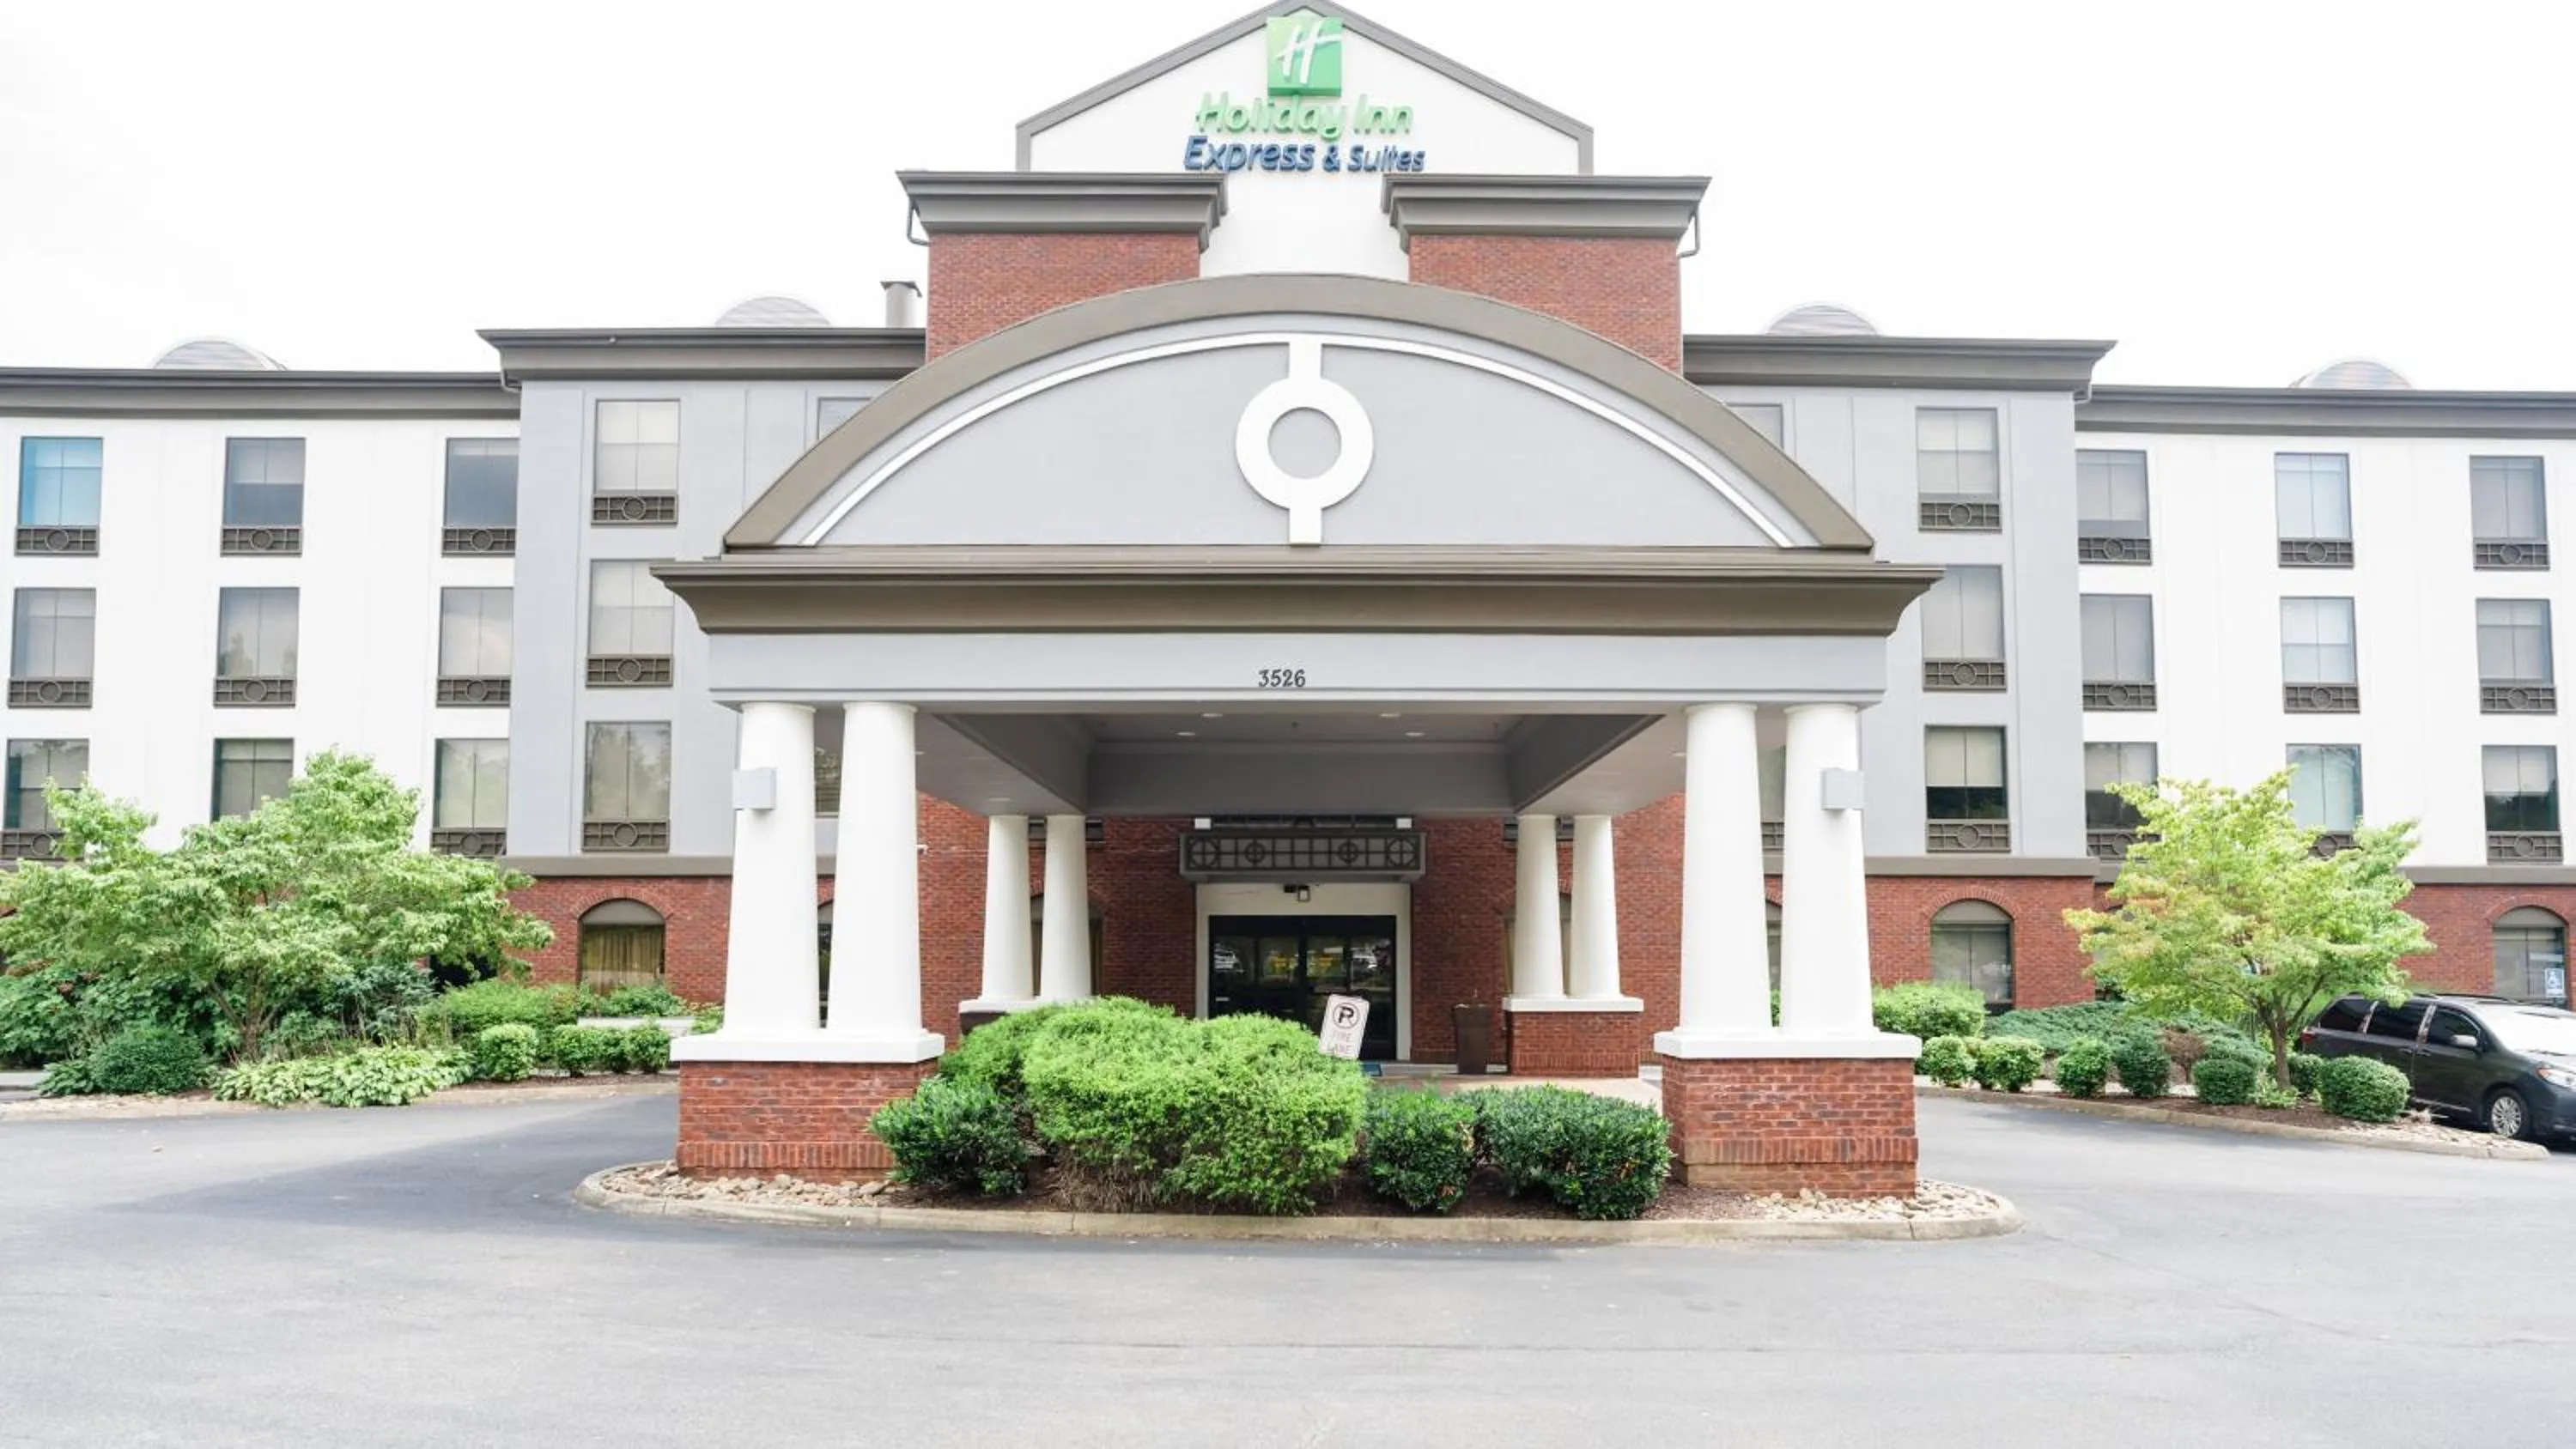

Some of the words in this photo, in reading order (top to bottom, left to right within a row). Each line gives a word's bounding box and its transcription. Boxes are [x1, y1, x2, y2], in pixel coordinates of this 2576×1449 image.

[1196, 92, 1346, 141] Holiday
[1353, 94, 1414, 135] Inn
[1183, 135, 1316, 173] Express
[1321, 145, 1341, 173] &
[1346, 144, 1426, 173] Suites
[1258, 669, 1306, 688] 3526
